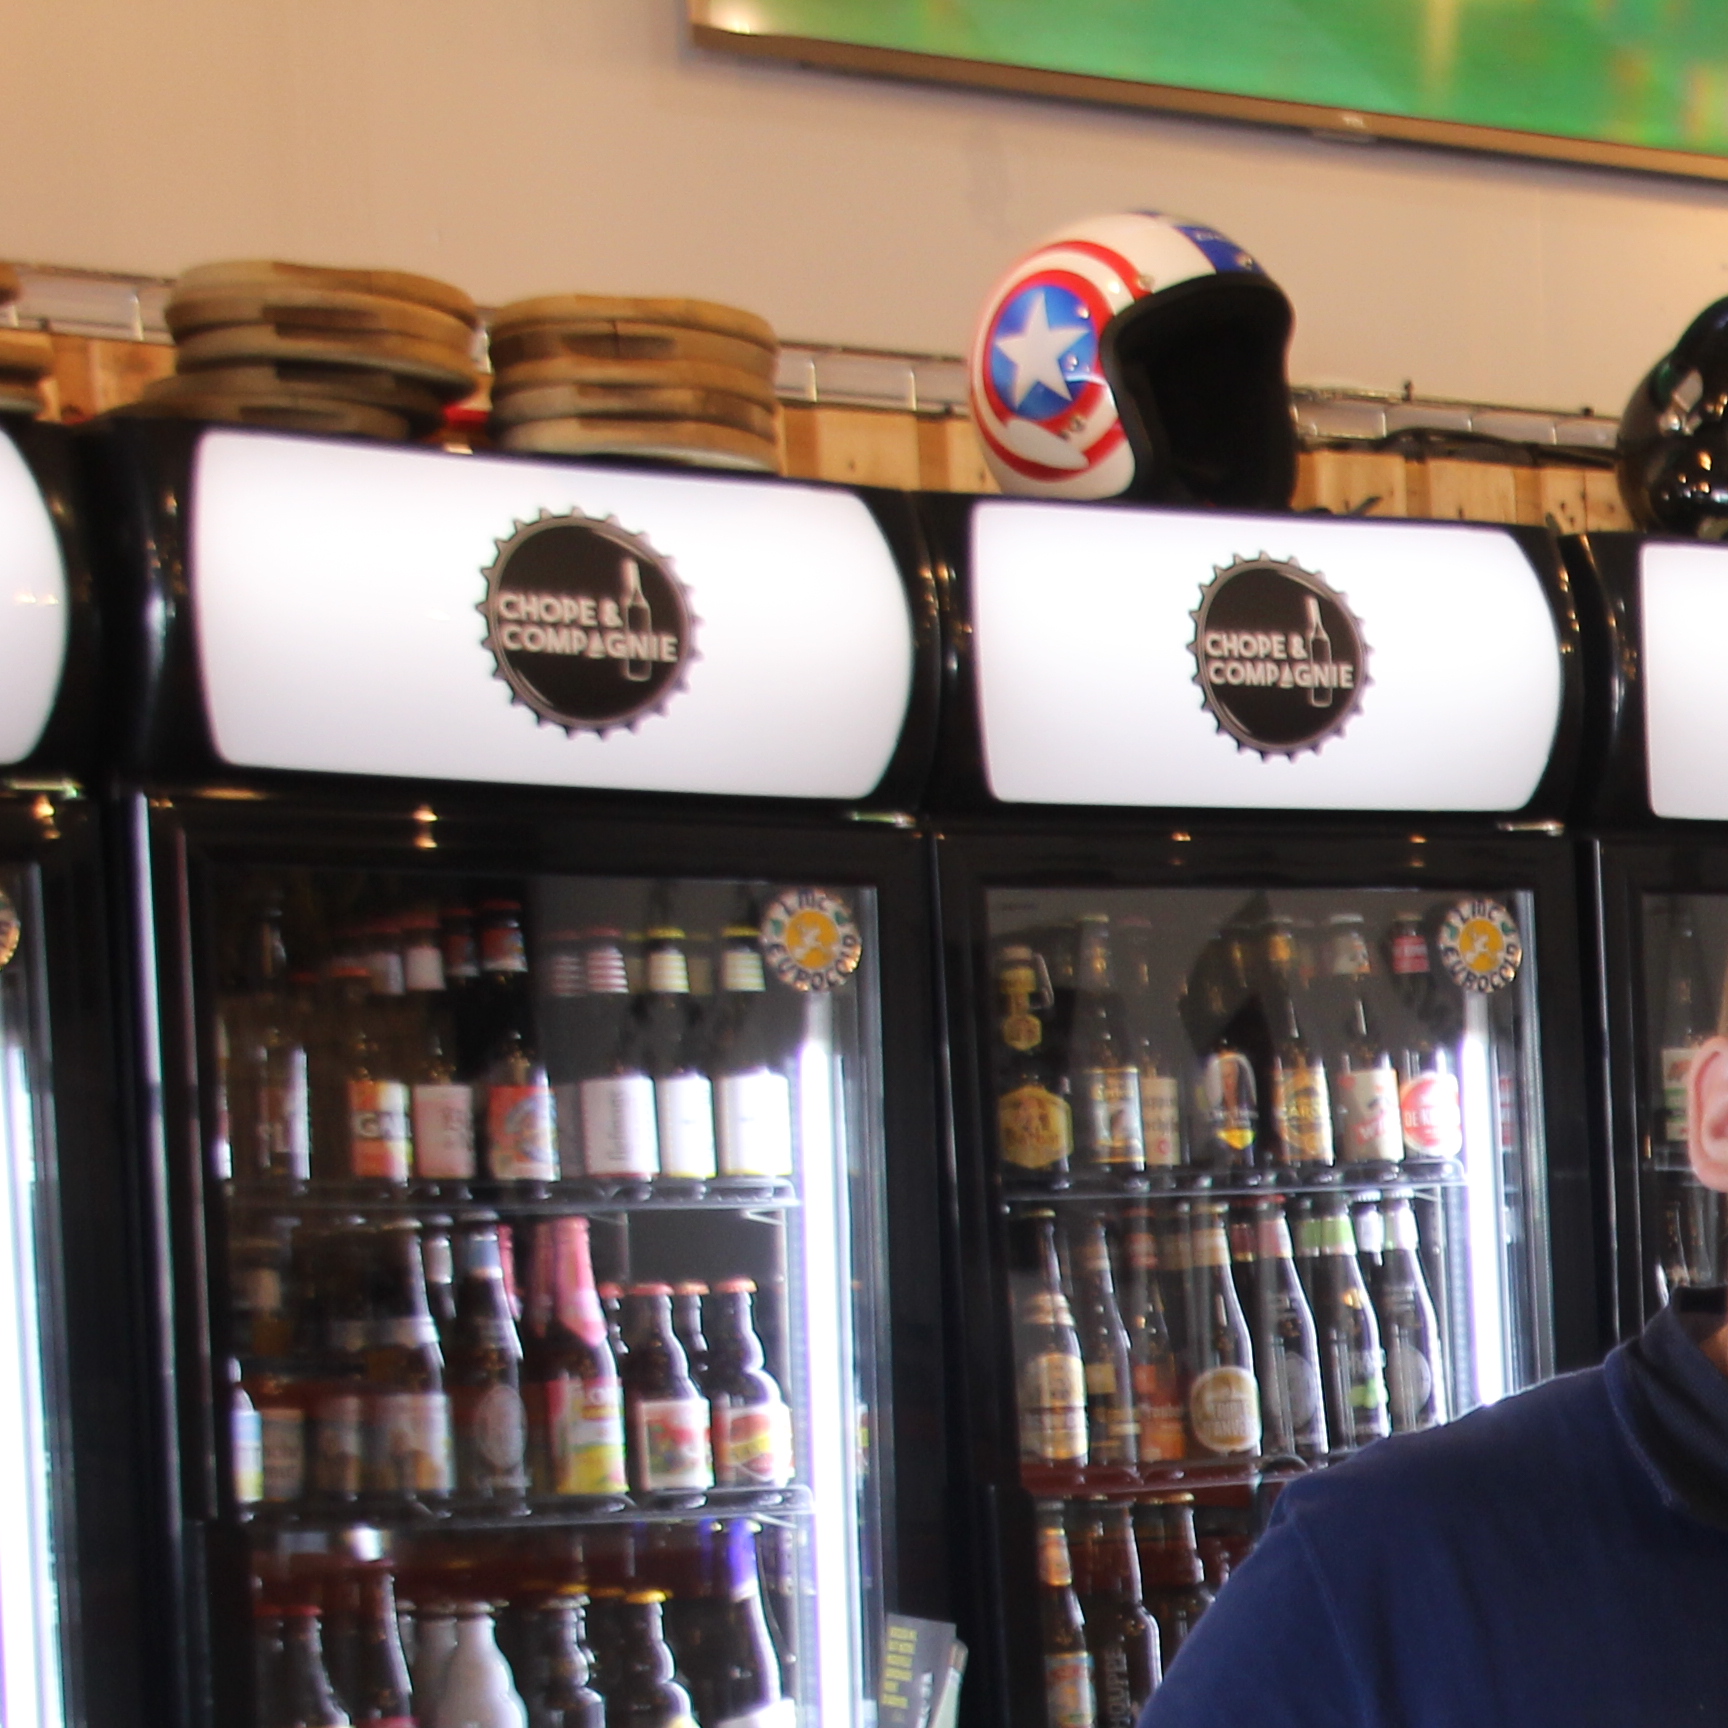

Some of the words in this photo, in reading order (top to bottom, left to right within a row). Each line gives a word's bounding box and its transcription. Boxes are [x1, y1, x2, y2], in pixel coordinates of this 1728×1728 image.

[499, 592, 598, 627] CHOPE
[600, 596, 624, 627] &
[501, 622, 679, 663] COMPAGNIE
[1206, 632, 1288, 660] CHOPE
[1288, 634, 1308, 660] &
[1208, 659, 1355, 690] COMPAGNIE
